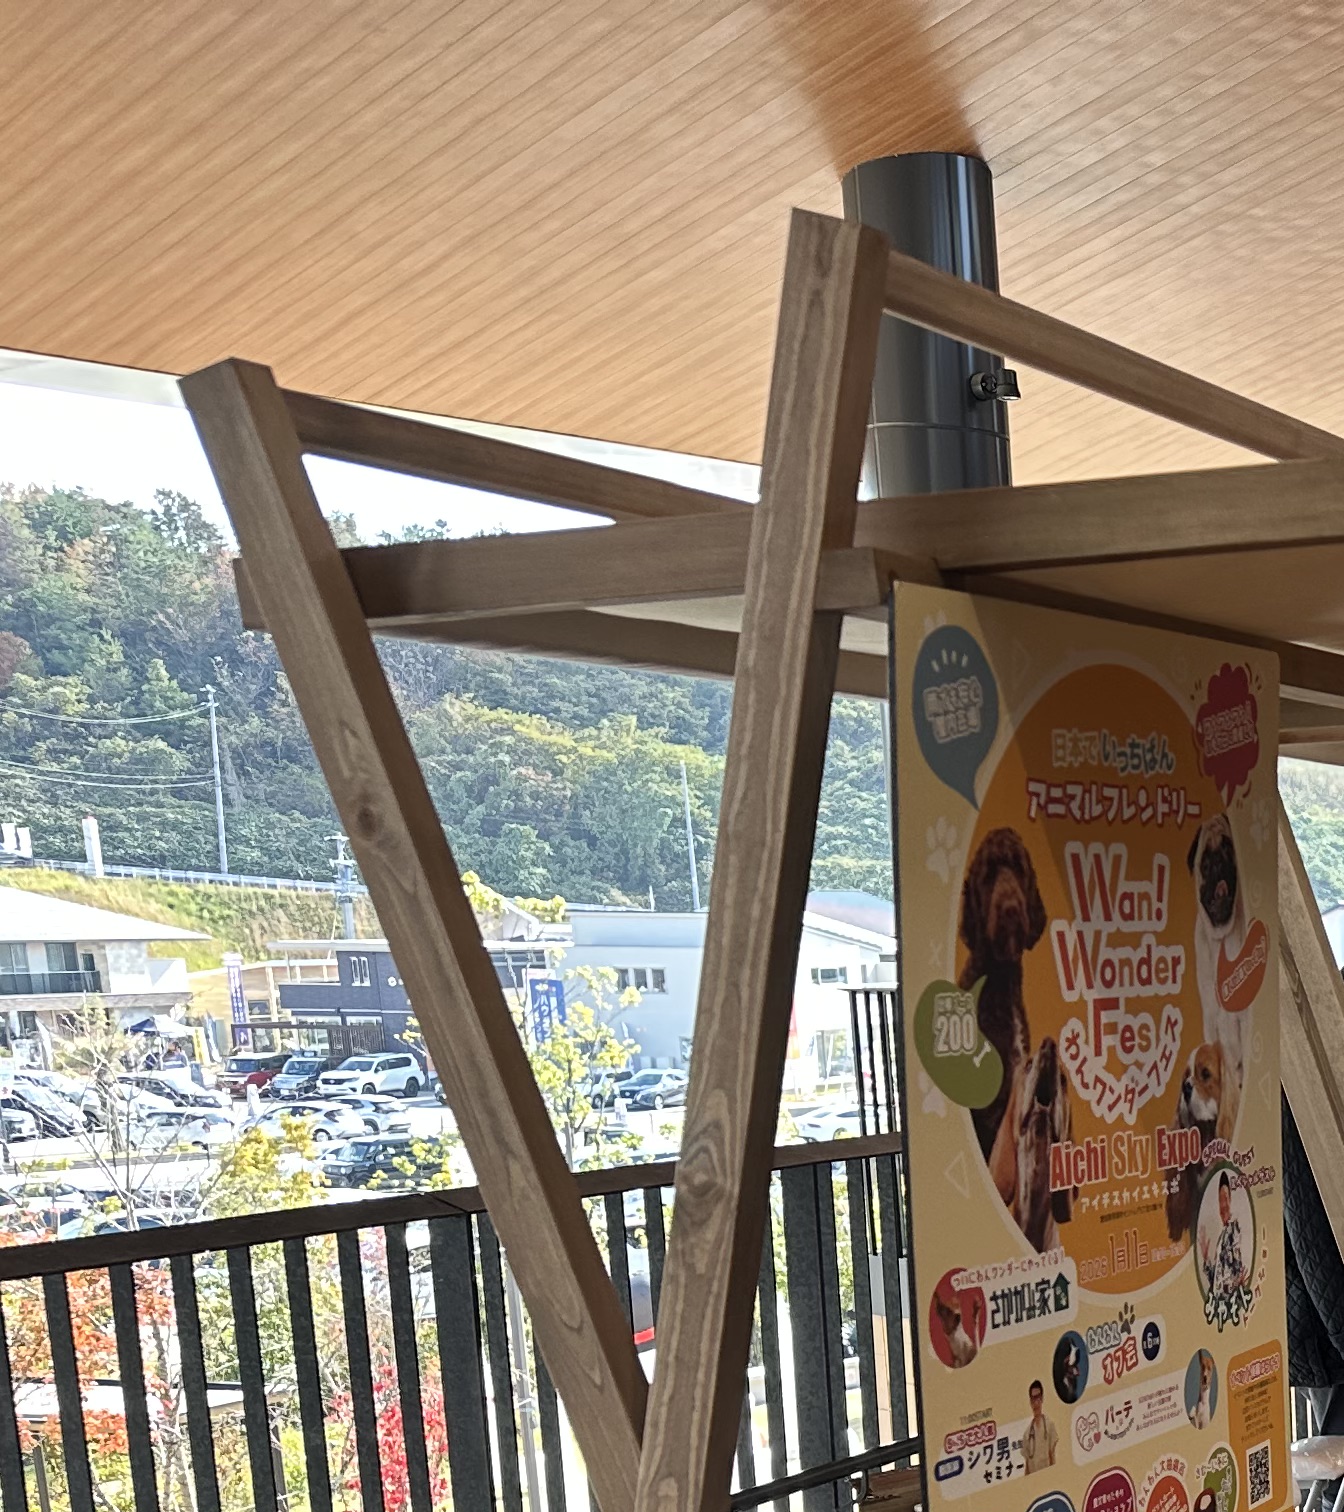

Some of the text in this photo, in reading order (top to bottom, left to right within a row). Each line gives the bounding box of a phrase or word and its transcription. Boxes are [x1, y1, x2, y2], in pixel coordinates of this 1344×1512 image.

[1027, 778, 1201, 828] アニマルフレンドリー
[1070, 852, 1165, 922] Wan!
[1055, 929, 1182, 992] Wonder
[936, 1014, 976, 1054] 200
[1093, 997, 1152, 1057] Fes
[1064, 1013, 1179, 1115] わんワンダーフェス
[1050, 1126, 1201, 1192] Aichi Sky Expo
[1080, 1174, 1181, 1213] アイチスカイエキスポ
[983, 1462, 1025, 1484] セミナー
